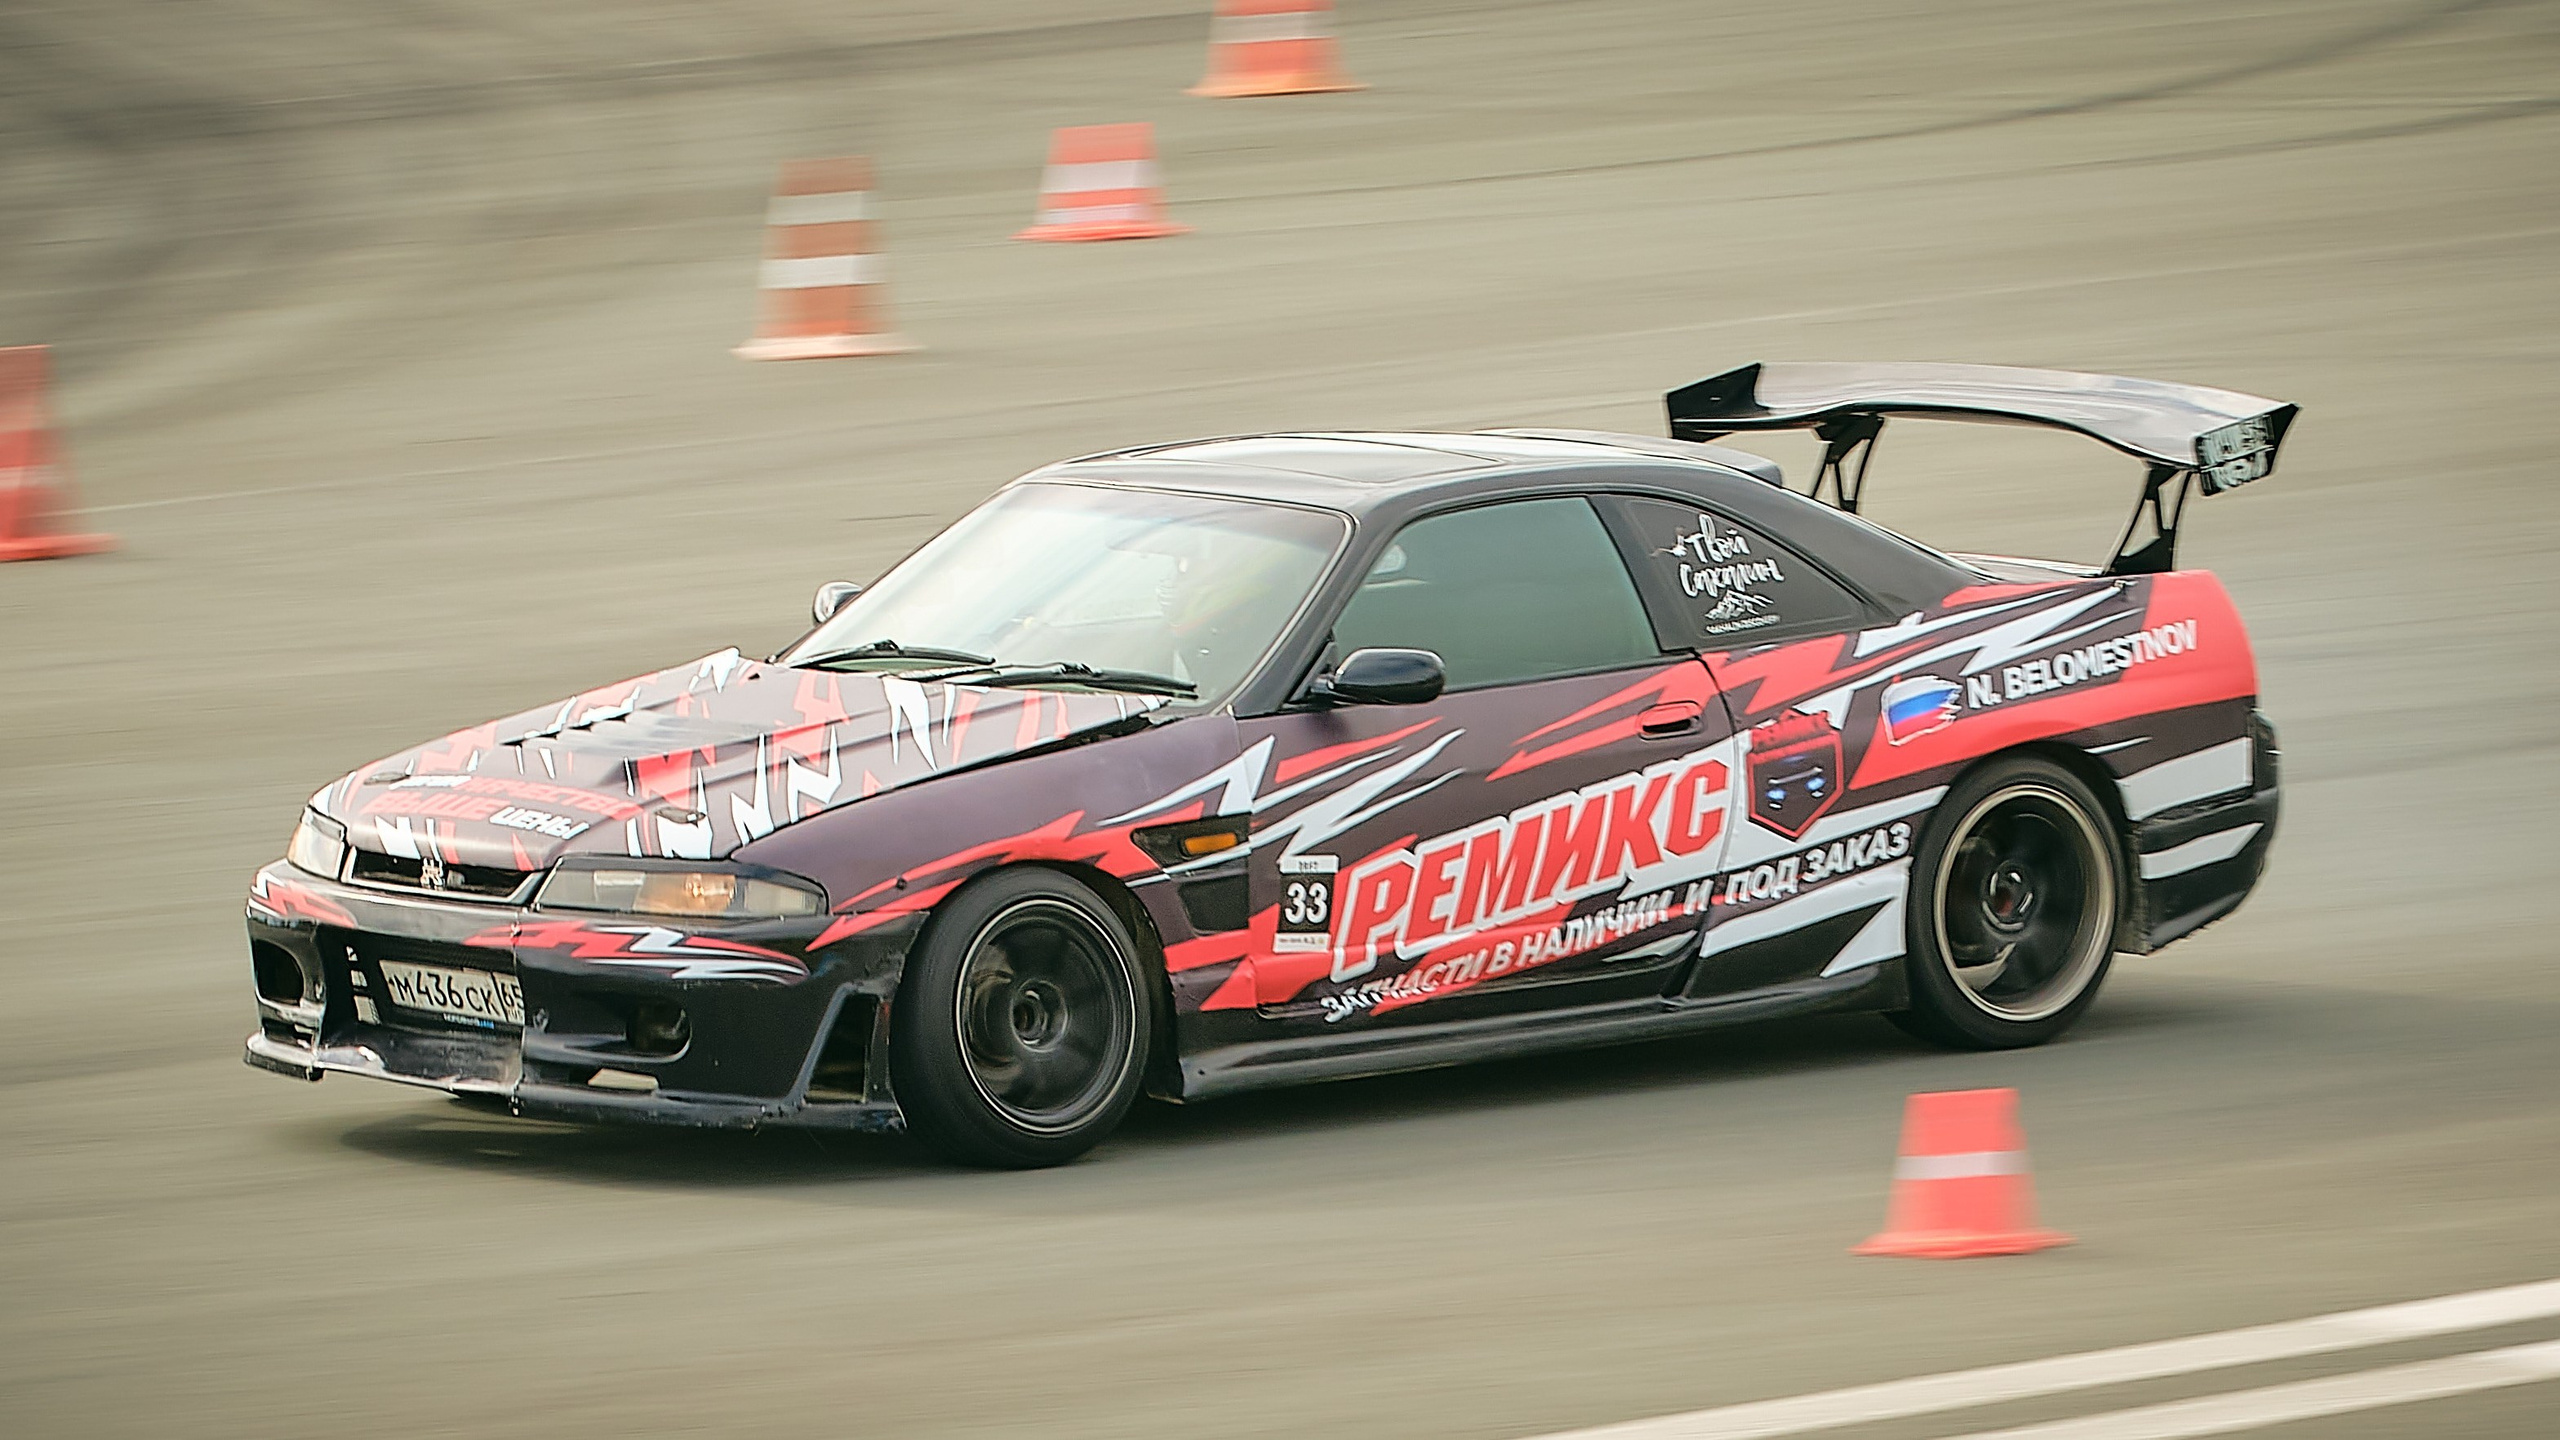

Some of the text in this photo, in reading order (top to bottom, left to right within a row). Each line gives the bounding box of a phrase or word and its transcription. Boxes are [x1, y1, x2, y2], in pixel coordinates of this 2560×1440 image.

[1966, 618, 2199, 709] N. BELOMESTNOV
[489, 805, 590, 840] ЦЕНЫ
[1340, 756, 1731, 970] РЕМИКС
[1284, 882, 1328, 924] 33
[1320, 821, 1912, 1023] ЗАПЧАСТИ В НАЛИЧИИ И ПОД ЗАКАЗ
